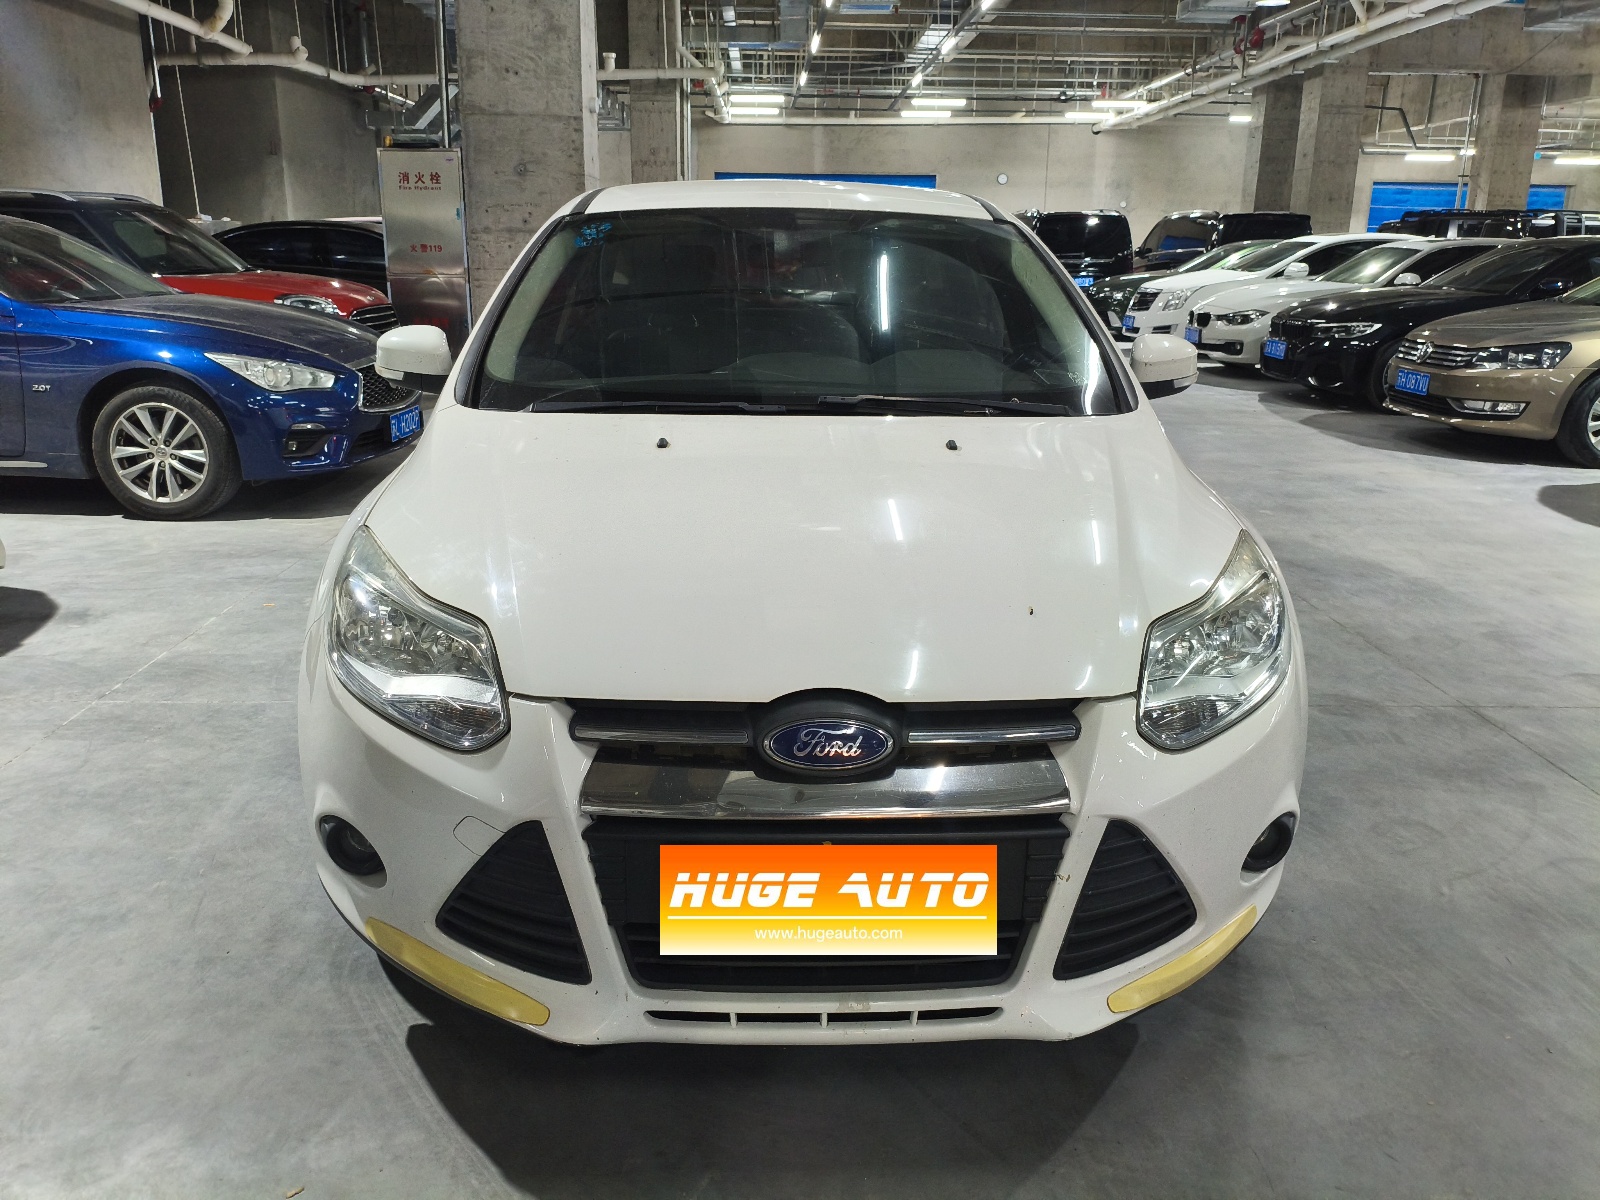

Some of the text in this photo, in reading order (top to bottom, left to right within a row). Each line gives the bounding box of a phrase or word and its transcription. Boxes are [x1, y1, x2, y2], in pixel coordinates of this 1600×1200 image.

[398, 171, 441, 185] 消火栓
[793, 727, 863, 757] Ford
